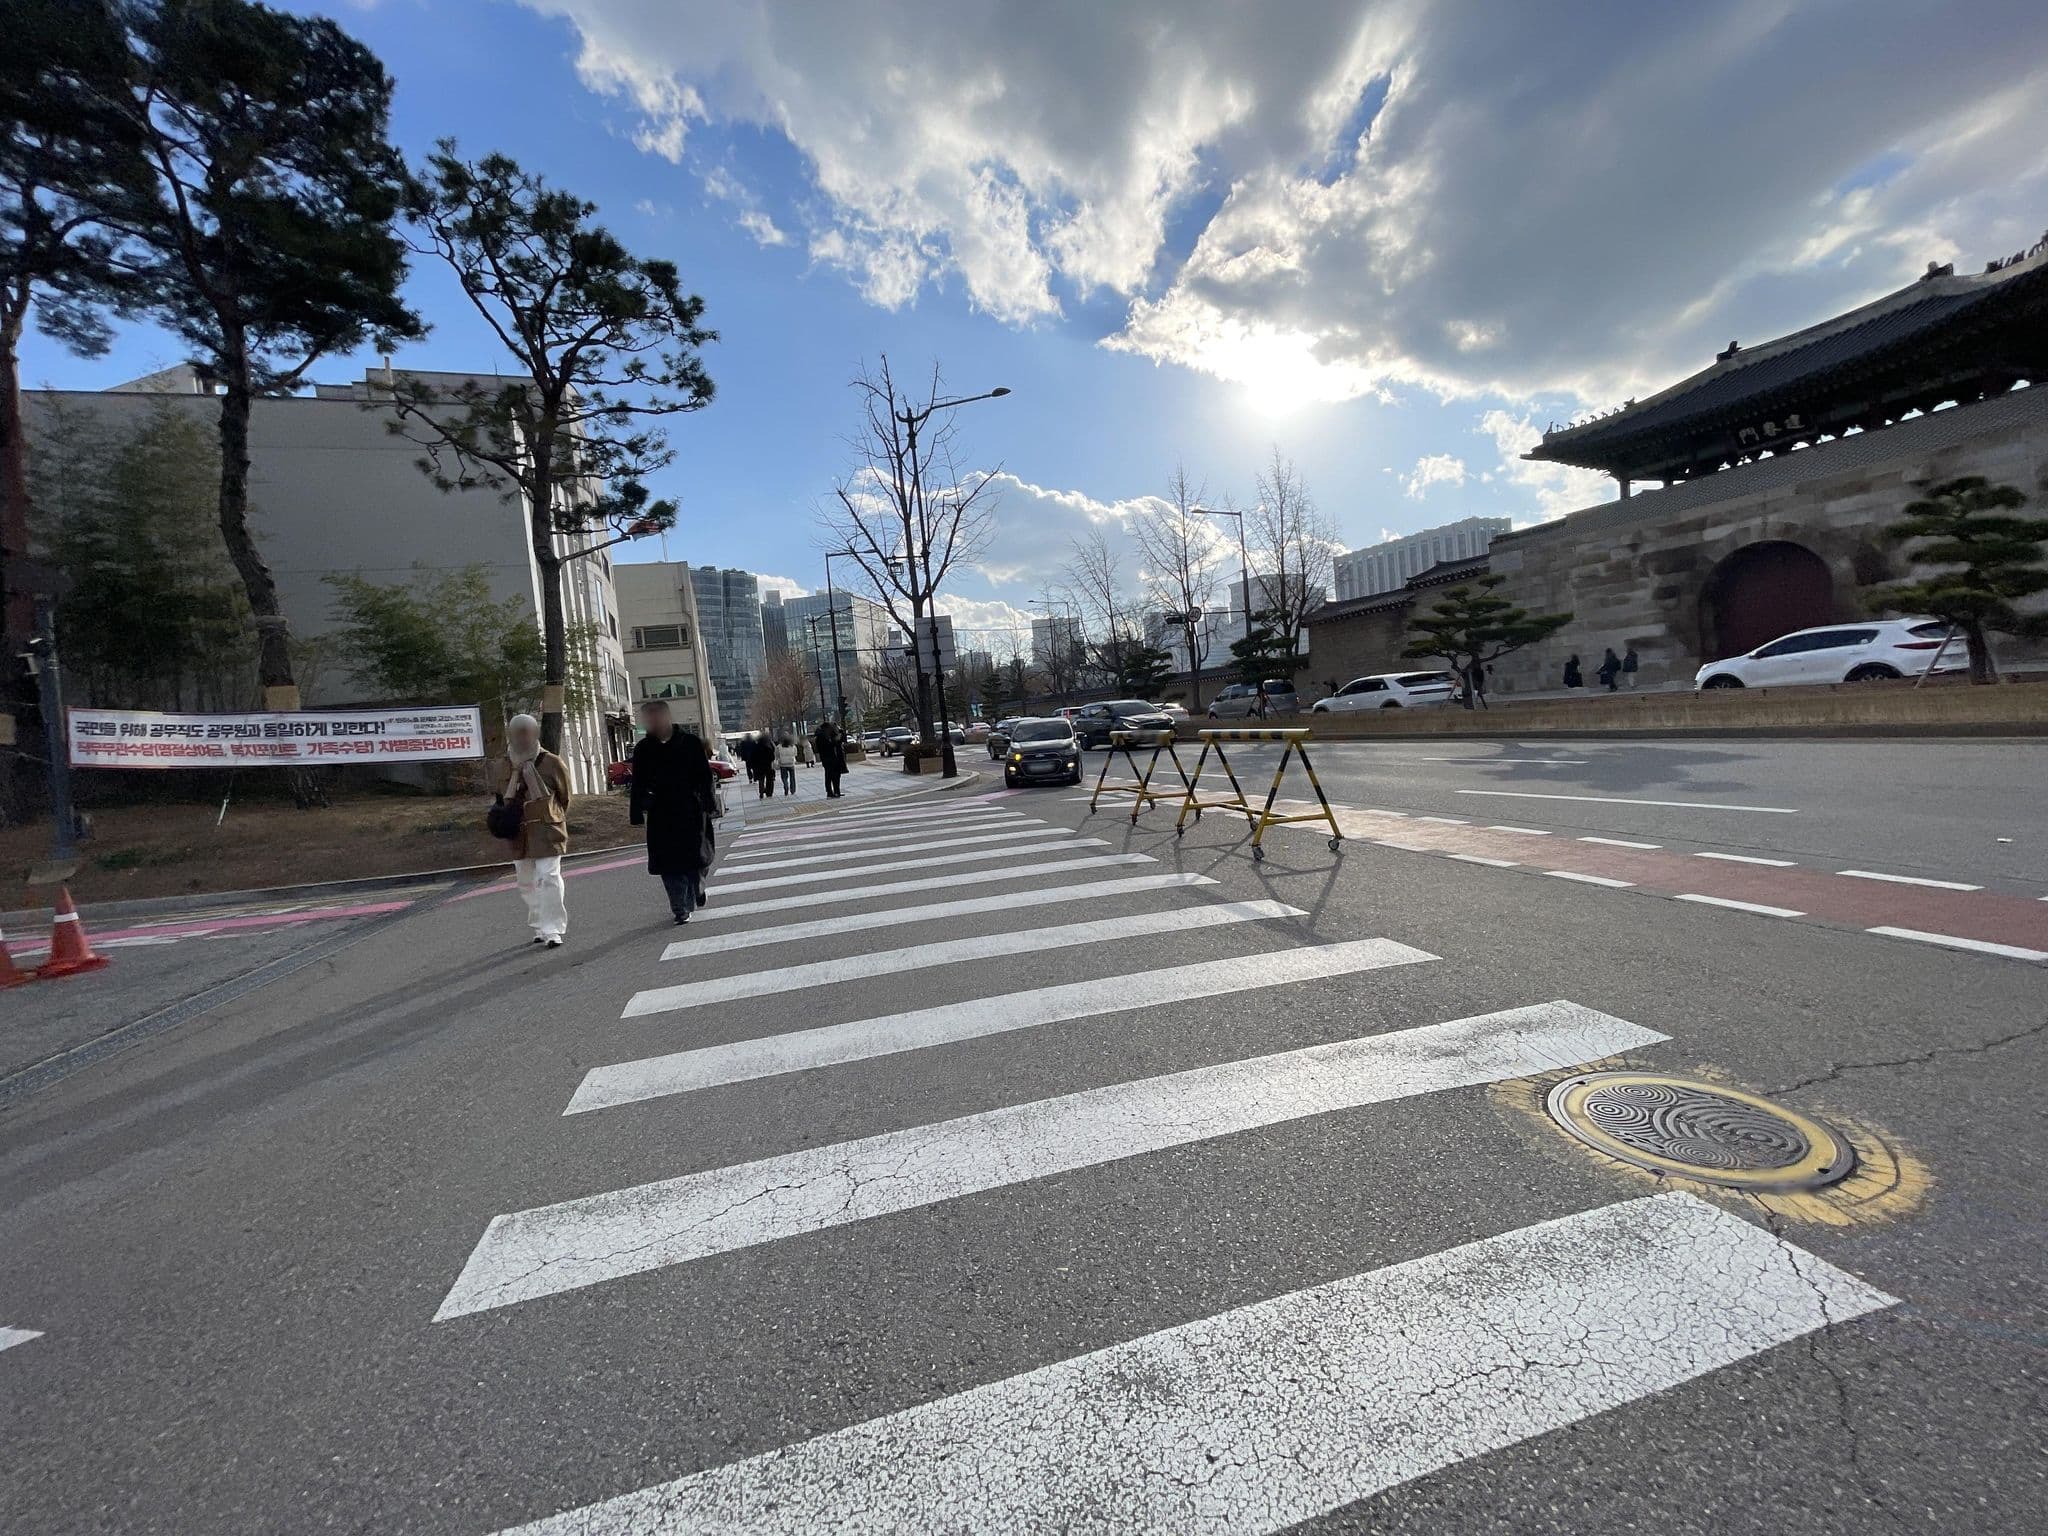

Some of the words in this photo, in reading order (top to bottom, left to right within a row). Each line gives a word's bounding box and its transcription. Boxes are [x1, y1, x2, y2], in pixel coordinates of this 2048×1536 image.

[75, 721, 117, 736] 국민을
[120, 722, 147, 737] 위해
[150, 723, 204, 738] 공무직도
[207, 723, 261, 738] 공무원과
[264, 722, 328, 738] 동일하게
[332, 721, 385, 736] 일한다!
[307, 741, 374, 755] 가족수당)
[379, 737, 471, 753] 차별중단하라!
